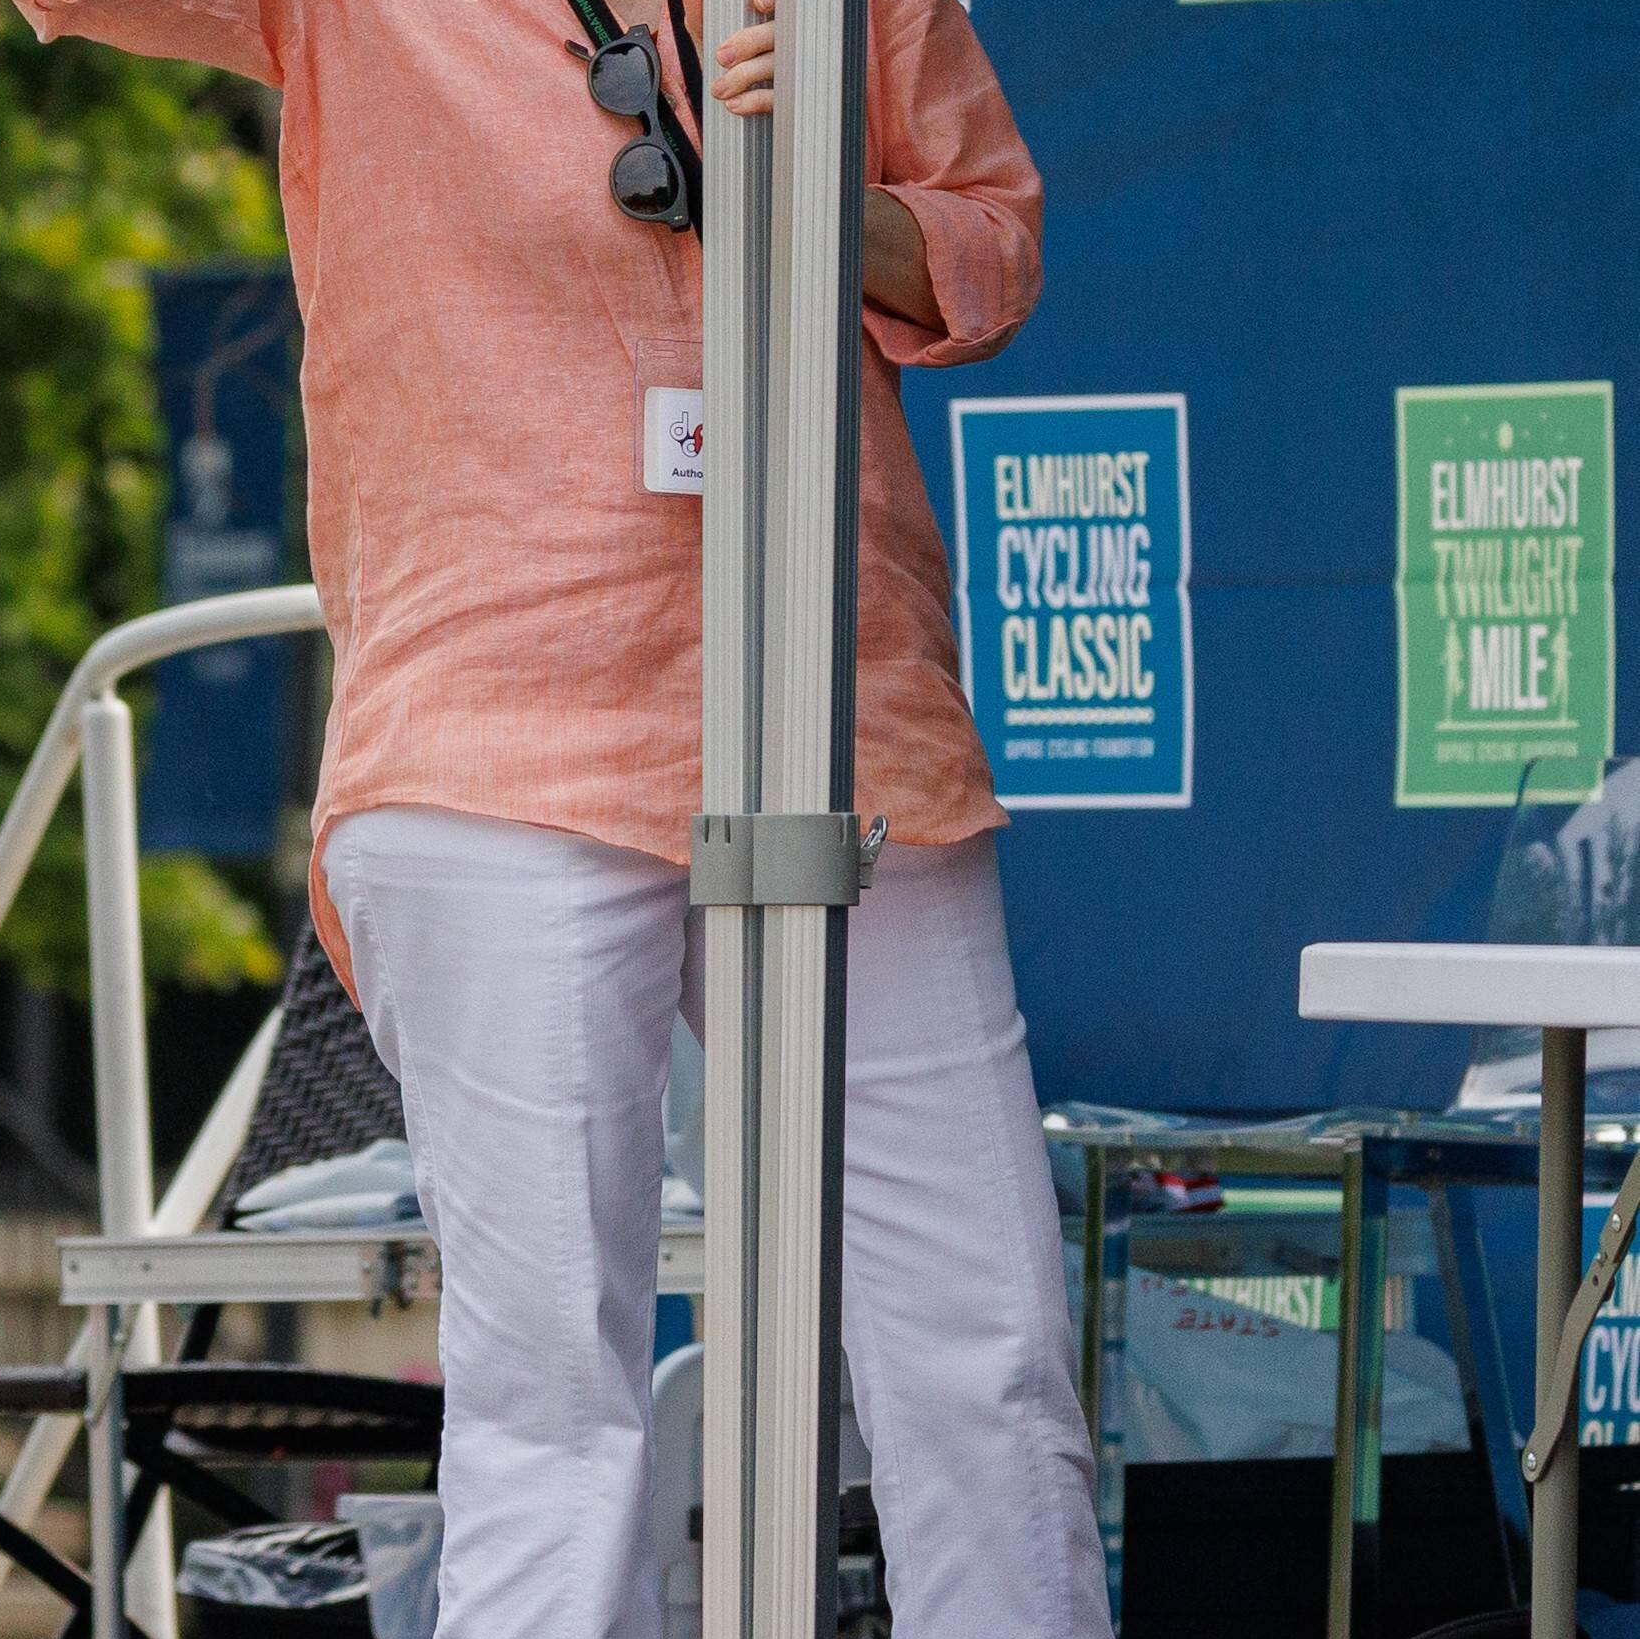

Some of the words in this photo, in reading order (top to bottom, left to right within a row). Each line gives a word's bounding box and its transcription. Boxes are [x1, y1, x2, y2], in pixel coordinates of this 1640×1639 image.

[993, 451, 1150, 520] ELMHURST
[1430, 457, 1584, 531] ELMHURST
[997, 523, 1152, 610] CYCLING
[1432, 536, 1585, 619] TWILIGHT
[1001, 613, 1155, 701] CLASSIC
[1469, 623, 1550, 710] MILE
